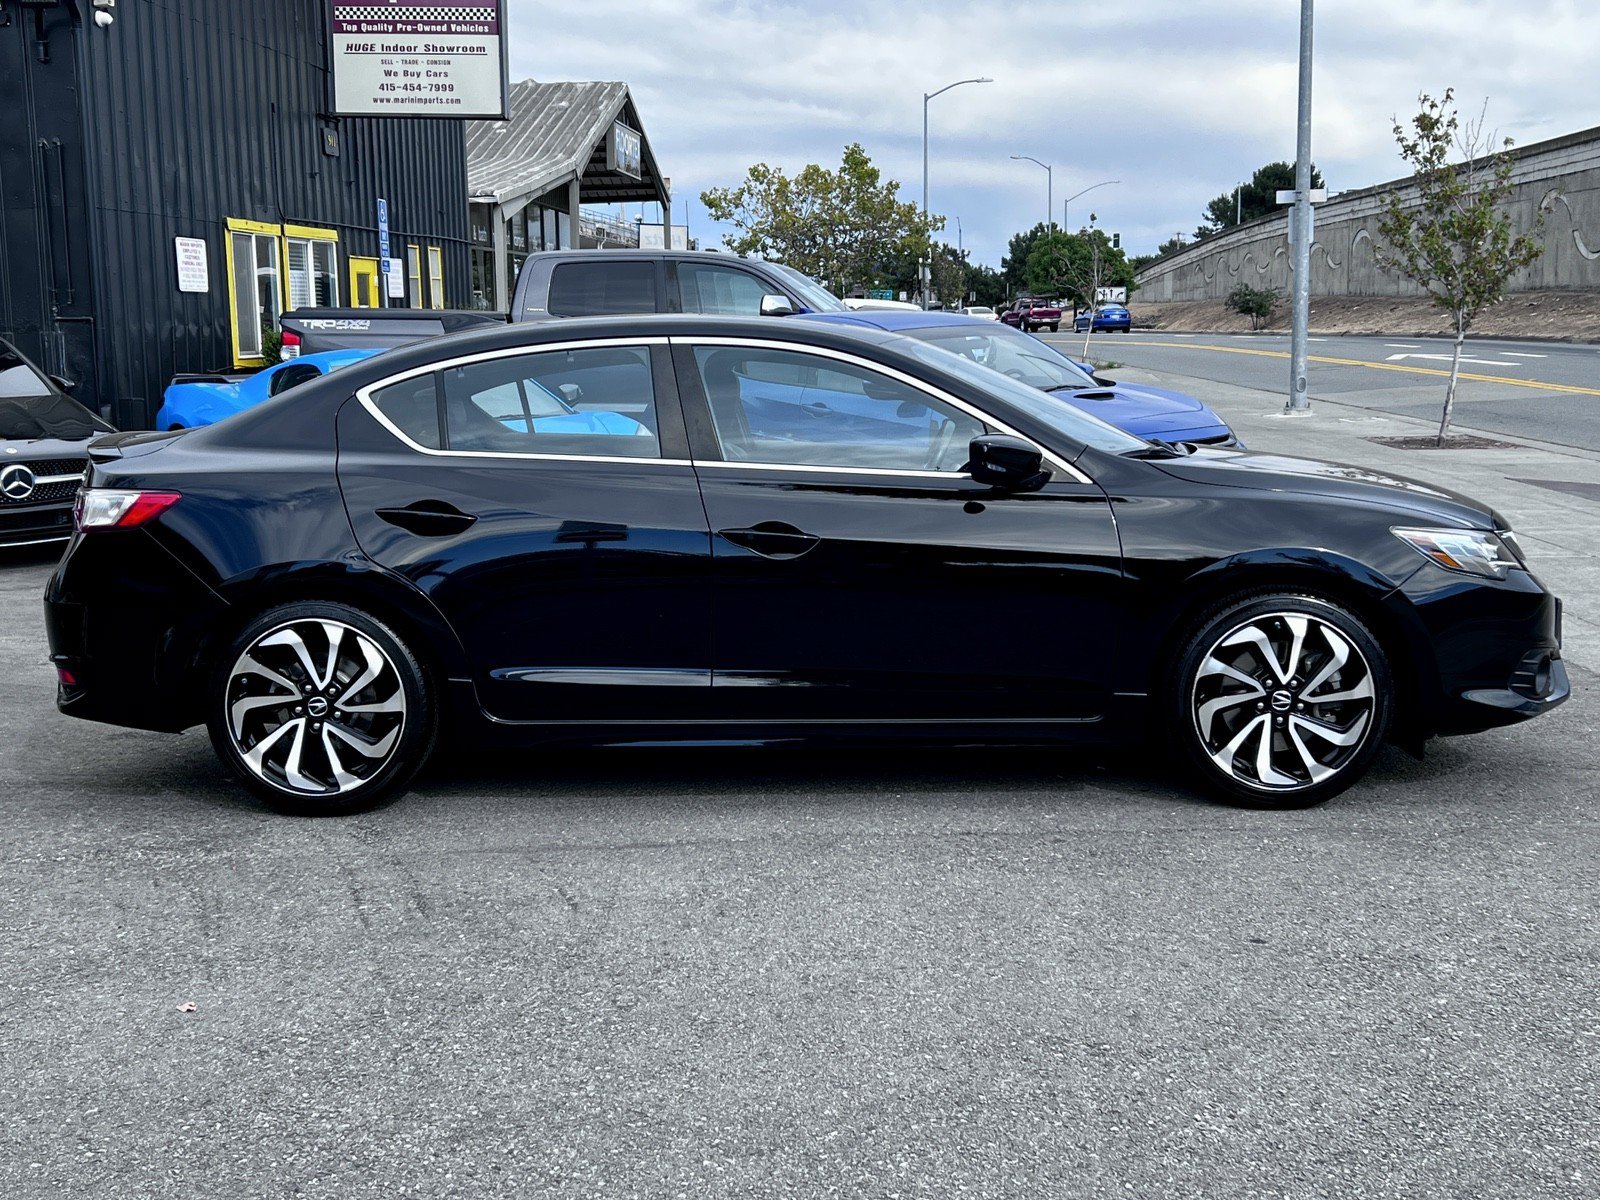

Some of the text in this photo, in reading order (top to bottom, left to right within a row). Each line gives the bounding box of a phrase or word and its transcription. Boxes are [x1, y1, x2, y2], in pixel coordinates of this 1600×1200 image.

[342, 23, 489, 32] Top Quality Pre-Owned Vehicles
[346, 44, 486, 52] HUGE Indoor Showroom
[403, 70, 421, 78] Buy
[378, 84, 454, 92] 415-454-7999
[372, 96, 461, 104] www.marinimports.com
